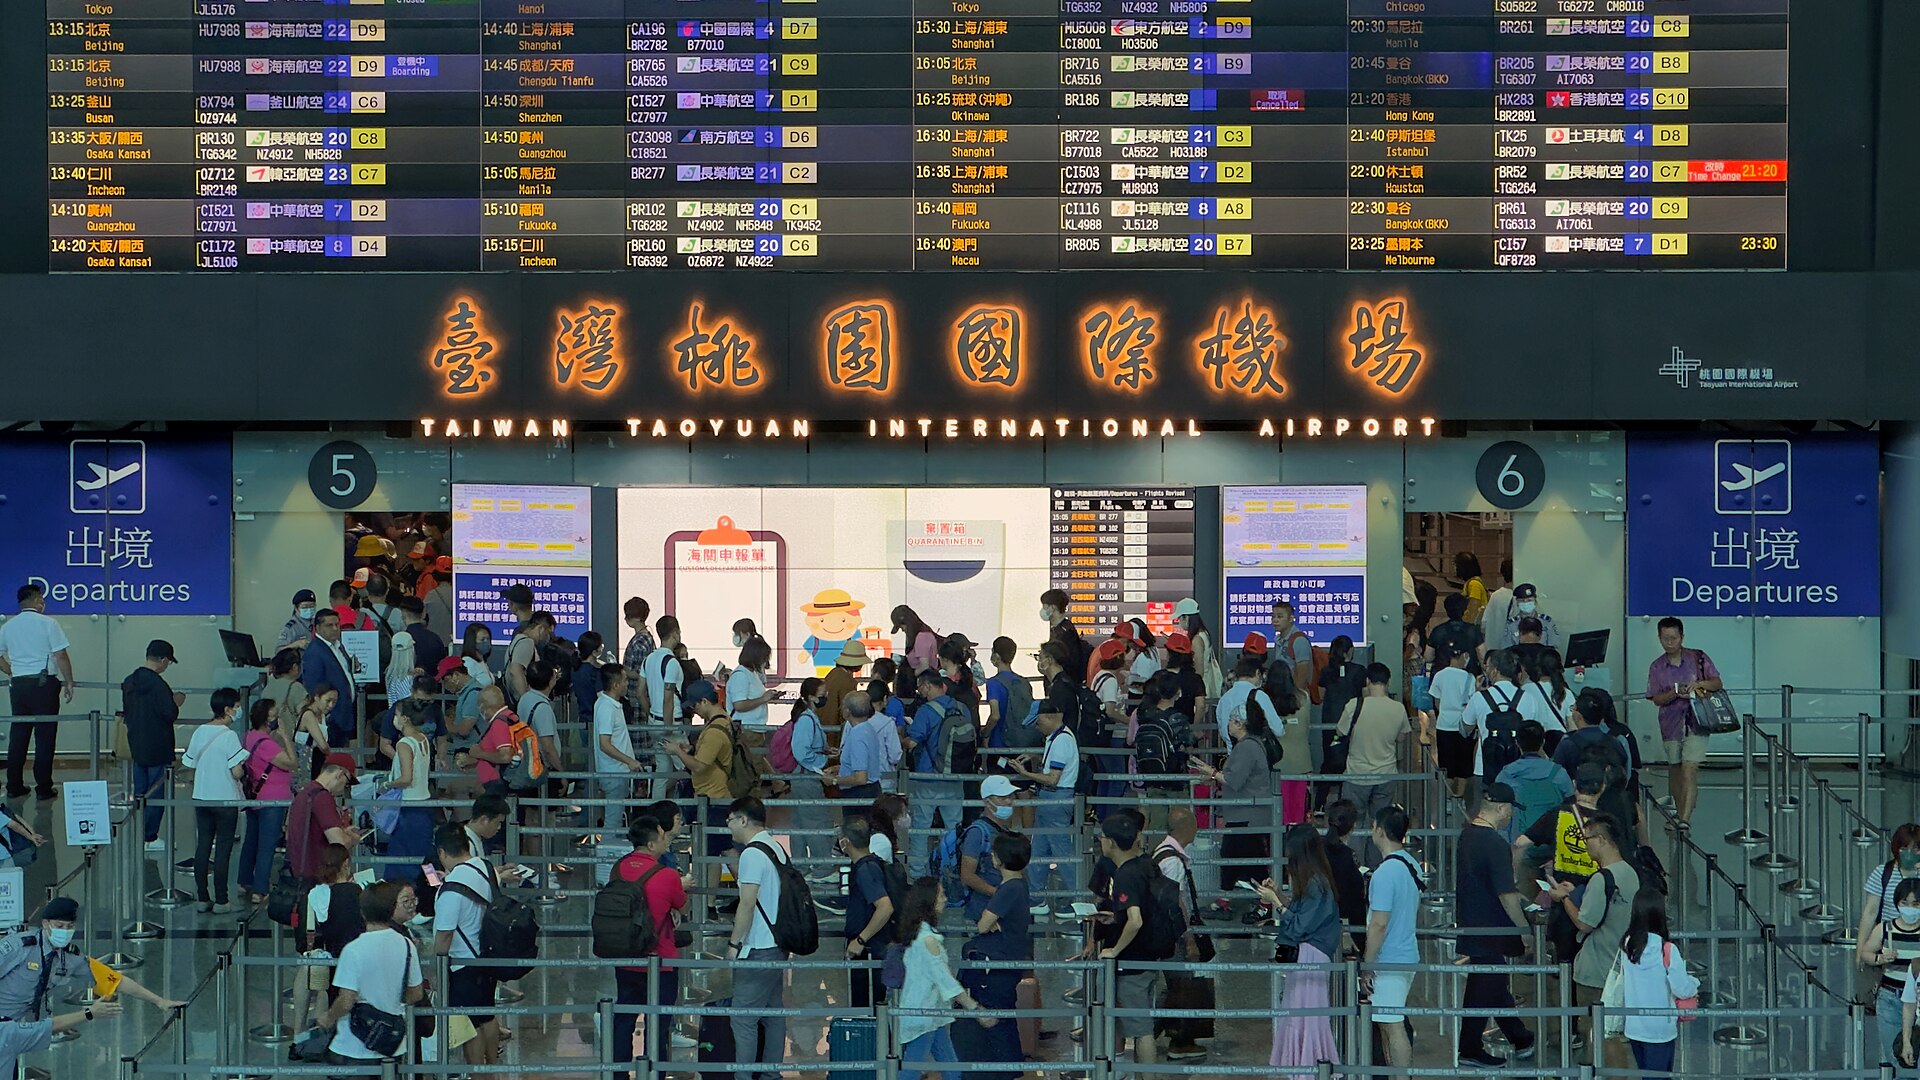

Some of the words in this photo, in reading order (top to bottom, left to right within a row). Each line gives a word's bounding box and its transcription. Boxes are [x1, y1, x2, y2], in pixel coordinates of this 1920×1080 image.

[50, 60, 84, 72] 13:15
[87, 60, 110, 72] 北京
[200, 61, 240, 72] HU7988
[270, 60, 322, 73] 海南航空
[328, 61, 346, 72] 22
[358, 61, 378, 72] D9
[916, 58, 950, 70] 16:05
[952, 58, 976, 70] 北京
[1066, 58, 1099, 70] BR716
[1135, 57, 1188, 70] 長榮航空
[1194, 59, 1211, 70] 21
[1224, 59, 1243, 70] B9
[392, 67, 430, 76] Boarding
[86, 76, 124, 88] Beijing
[952, 75, 990, 86] Beijing
[1066, 75, 1101, 85] CA5516
[916, 94, 950, 106] 16:25
[1066, 94, 1099, 106] BR186
[1135, 94, 1188, 107] 長榮航空
[1256, 100, 1298, 109] Cancelled
[952, 111, 989, 121] Okinawa
[50, 132, 85, 144] 13:35
[201, 133, 234, 144] BR130
[271, 132, 323, 145] 長榮航空
[328, 134, 347, 144] 20
[358, 133, 378, 144] C8
[484, 132, 517, 143] 14:50
[519, 131, 543, 144] 廣州
[632, 132, 672, 144] CZ3098
[701, 131, 754, 144] 南方航空
[764, 132, 773, 142] 3
[790, 132, 809, 142] D6
[1350, 130, 1384, 142] 21:40
[1386, 129, 1435, 143] 伊斯坦堡
[1500, 130, 1526, 142] TK25
[1634, 130, 1644, 140] 4
[1660, 130, 1681, 141] D8
[86, 148, 114, 159] Osaka
[118, 148, 151, 159] Kansai
[201, 149, 236, 160] TG6342
[257, 149, 293, 160] NZ4912
[305, 149, 342, 160] NH5828
[518, 148, 566, 159] Guangzhou
[632, 148, 667, 159] CI8521
[1386, 146, 1428, 157] Istanbul
[1500, 146, 1536, 157] BR2079
[484, 168, 517, 179] 15:05
[519, 167, 556, 180] 馬尼拉
[632, 168, 665, 179] BR277
[701, 167, 754, 180] 長榮航空
[760, 168, 776, 179] 21
[790, 167, 809, 178] C2
[1350, 166, 1384, 178] 22:00
[1386, 165, 1423, 179] 休士頓
[1500, 166, 1527, 178] BR52
[1570, 165, 1624, 179] 長榮航空
[1629, 166, 1648, 178] 20
[1660, 166, 1680, 177] C7
[1742, 165, 1777, 176] 21:20
[1688, 171, 1709, 181] Time
[1713, 171, 1741, 181] Change
[519, 184, 551, 195] Manila
[1386, 183, 1423, 193] Houston
[1500, 182, 1536, 193] TG6264
[51, 204, 85, 216] 14:10
[87, 204, 112, 216] 廣州
[201, 205, 234, 216] CI521
[271, 204, 323, 217] 中華航空
[334, 206, 343, 216] 7
[359, 206, 378, 216] D2
[484, 204, 517, 216] 15:10
[519, 204, 544, 216] 福岡
[632, 204, 665, 216] BR102
[701, 204, 754, 216] 長榮航空
[760, 204, 778, 215] 20
[790, 204, 808, 215] C1
[87, 221, 135, 232] Guangzhou
[201, 221, 237, 232] CZ7971
[519, 220, 557, 231] Fukuoka
[632, 220, 667, 231] TG6282
[688, 220, 724, 231] NZ4902
[736, 220, 773, 231] NH5848
[786, 220, 821, 231] TK9452
[916, 239, 950, 251] 16:40
[952, 239, 976, 252] 澳門
[1066, 240, 1099, 251] BR805
[1135, 239, 1188, 252] 長榮航空
[1195, 240, 1213, 250] 20
[1225, 240, 1243, 250] B7
[952, 256, 979, 266] Macau
[433, 302, 1421, 394] 臺灣桃園國際機場
[421, 419, 569, 437] TAIWAN
[627, 419, 809, 437] TAOYUAN
[870, 419, 1201, 437] INTERNATIONAL
[1259, 419, 1435, 437] AIRPORT
[330, 454, 357, 497] 5
[1497, 454, 1525, 497] 6
[66, 526, 153, 569] 出境
[907, 538, 965, 546] QUARANTINE
[1710, 527, 1800, 570] 出境
[28, 577, 190, 608] Departures
[1672, 578, 1838, 609] Departures
[1561, 854, 1593, 868] Timberland
